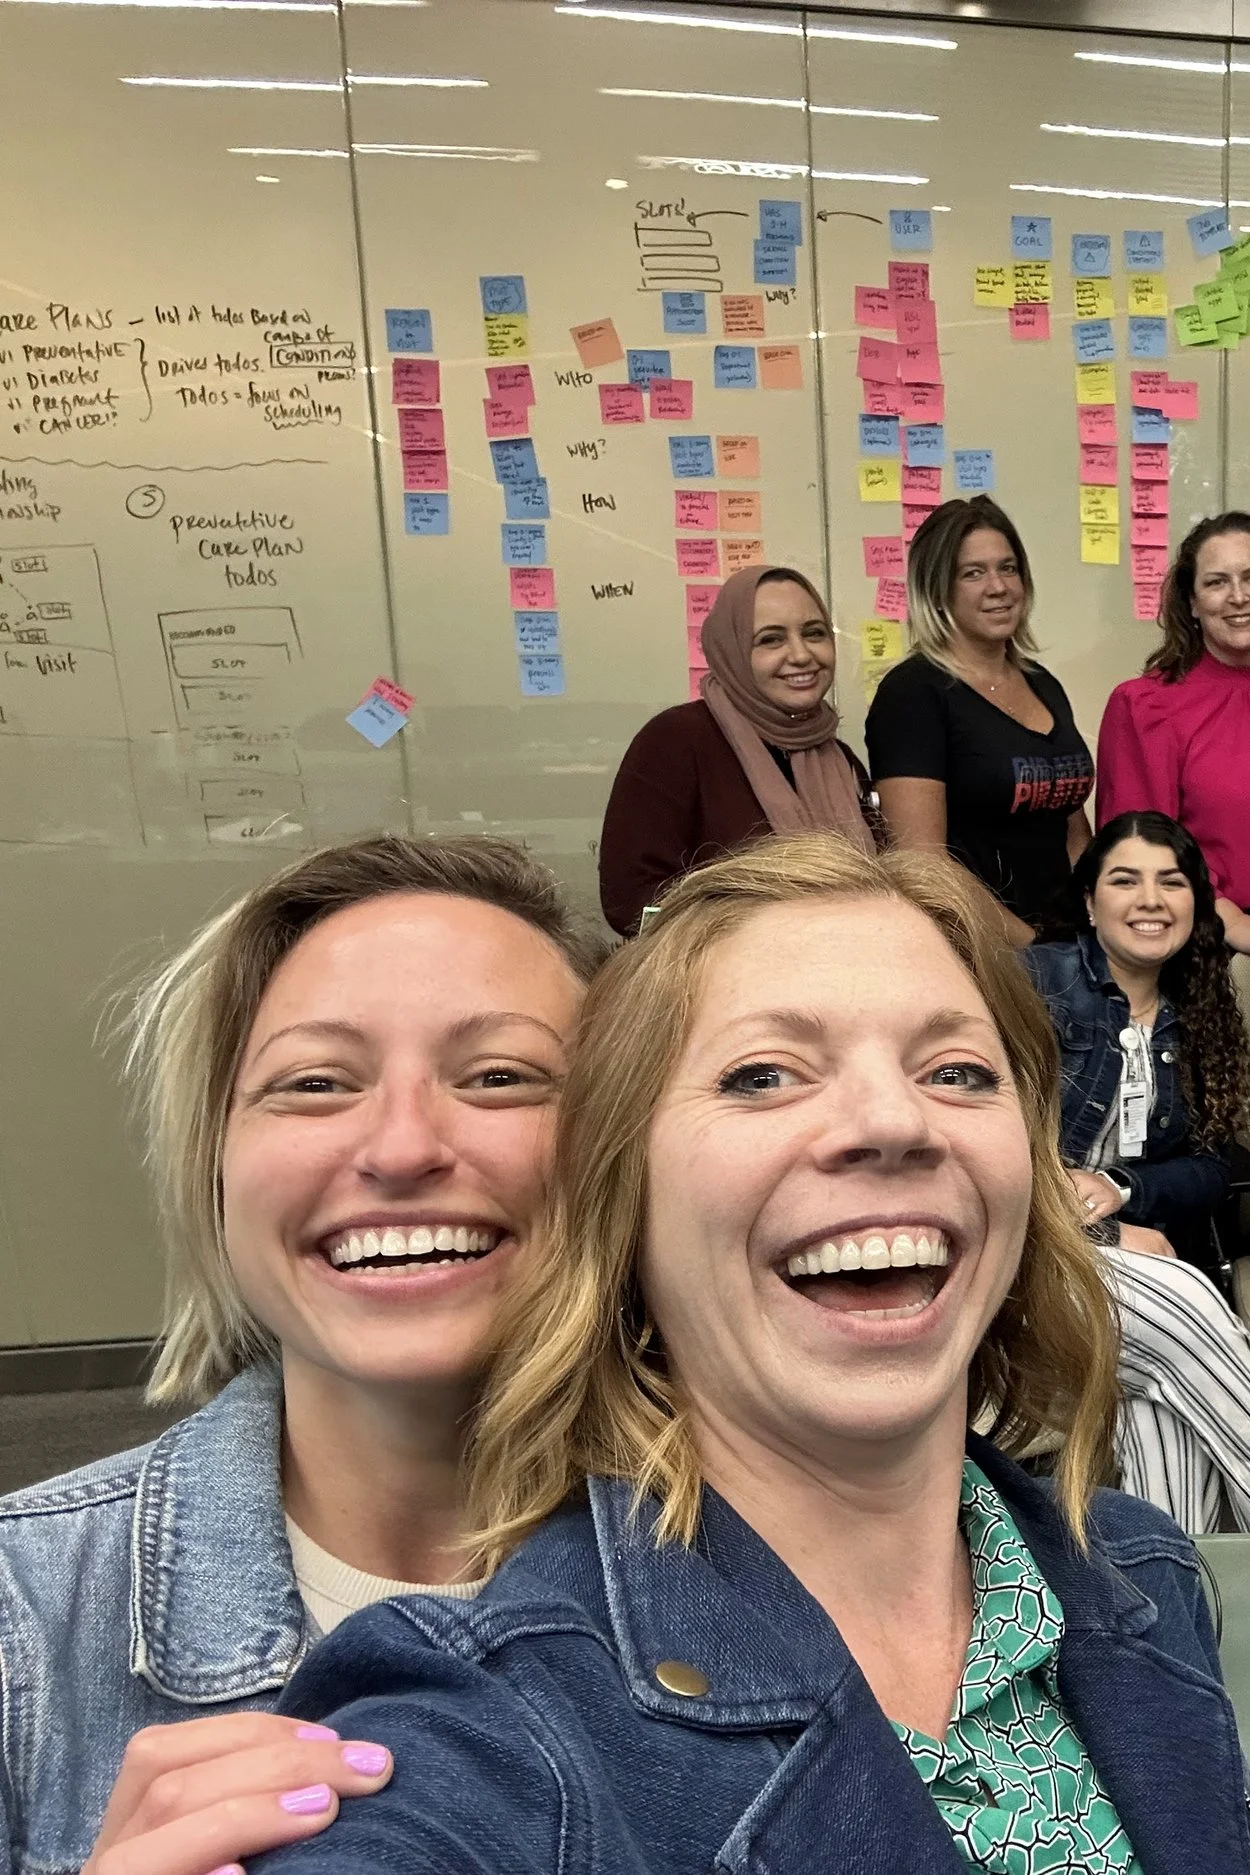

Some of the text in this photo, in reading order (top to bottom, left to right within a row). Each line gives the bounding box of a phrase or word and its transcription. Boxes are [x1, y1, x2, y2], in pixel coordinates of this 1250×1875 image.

[894, 223, 922, 235] USER
[1014, 236, 1044, 247] GOAL
[0, 312, 38, 334] are
